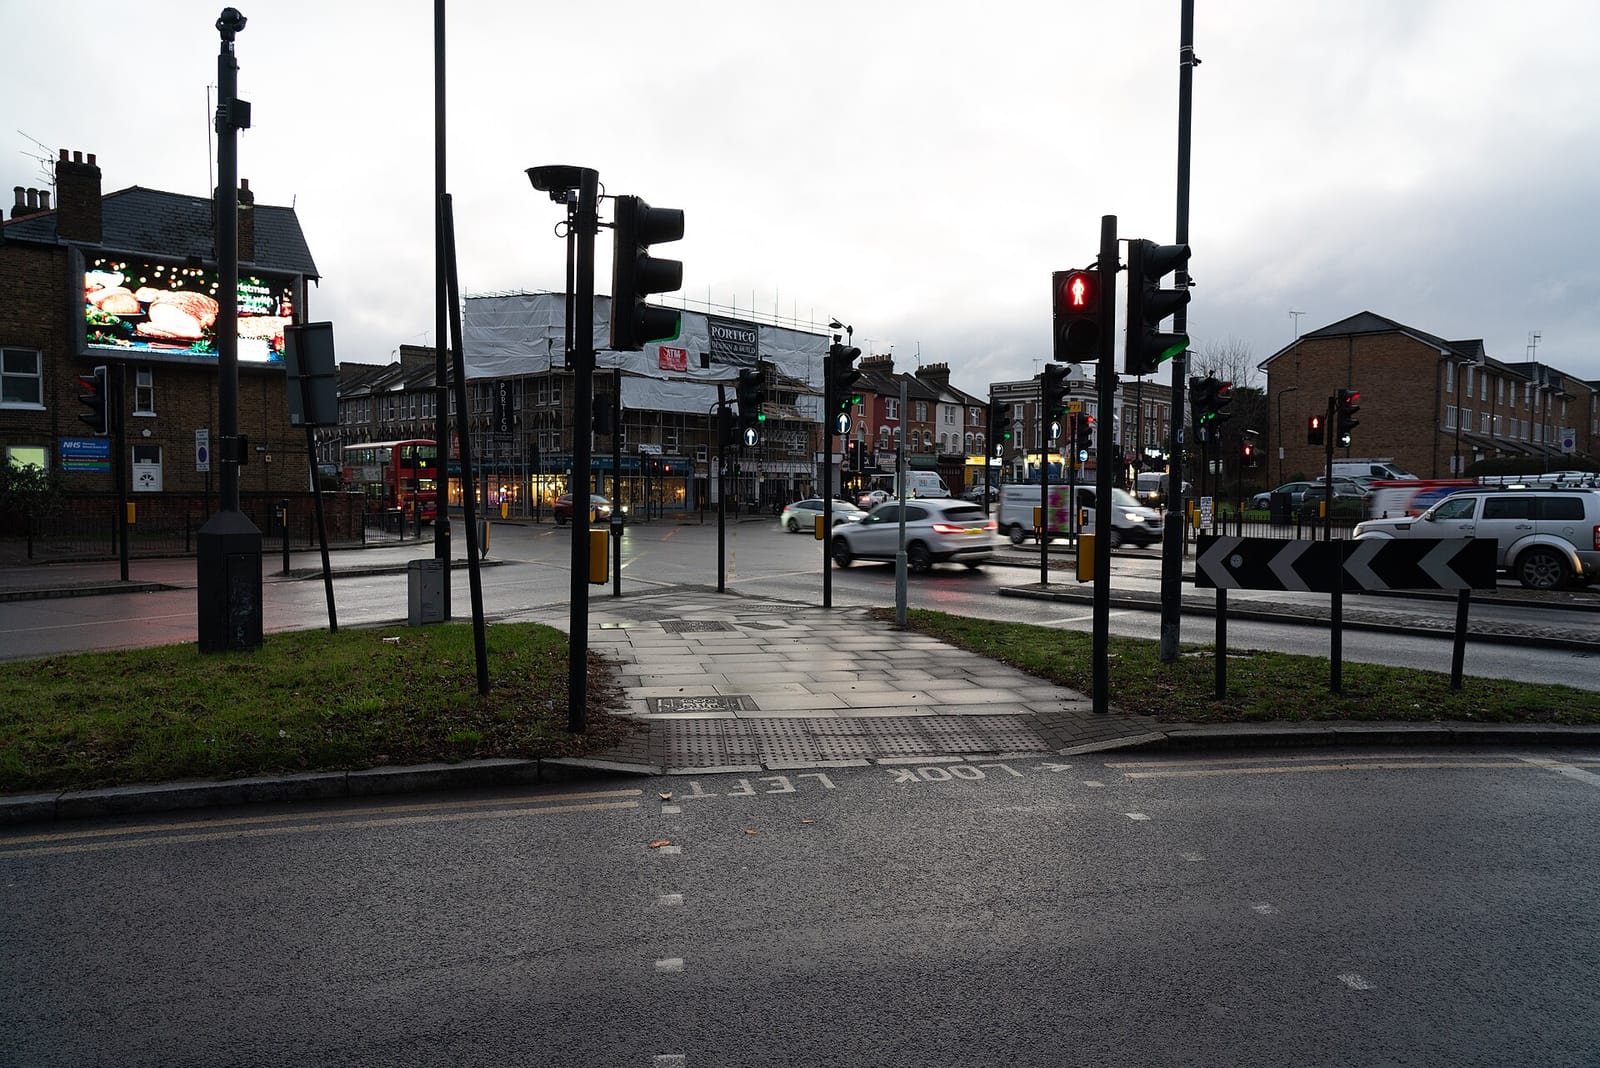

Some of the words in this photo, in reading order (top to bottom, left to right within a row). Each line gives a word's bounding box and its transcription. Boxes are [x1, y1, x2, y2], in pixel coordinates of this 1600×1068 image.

[237, 283, 270, 294] ristmas
[237, 305, 270, 314] rackle.
[711, 326, 756, 343] PORTICO
[500, 382, 508, 432] PORTICO
[64, 441, 81, 449] NHS
[887, 763, 1024, 783] LOOK
[681, 773, 836, 800] LEFT
